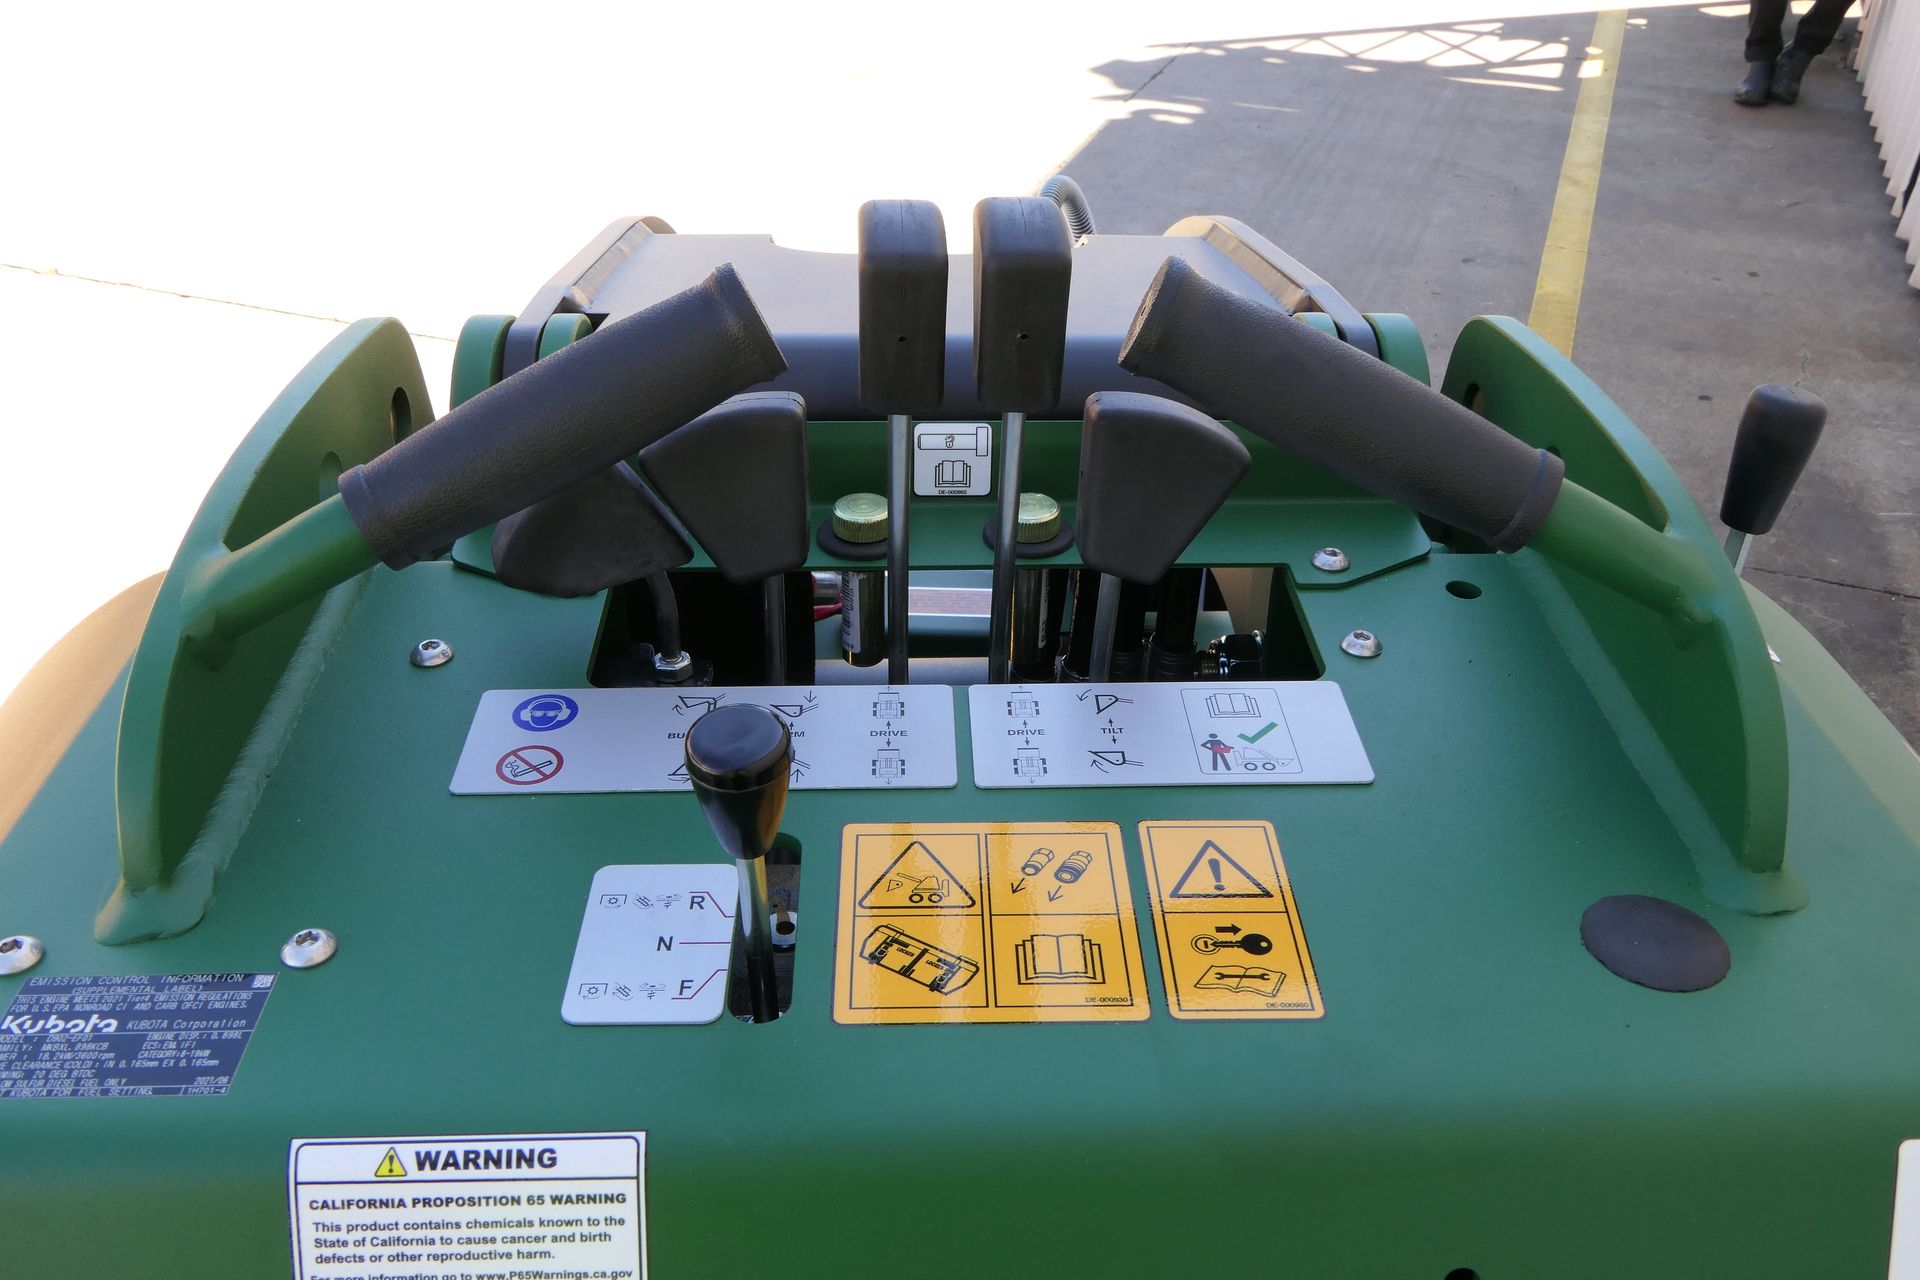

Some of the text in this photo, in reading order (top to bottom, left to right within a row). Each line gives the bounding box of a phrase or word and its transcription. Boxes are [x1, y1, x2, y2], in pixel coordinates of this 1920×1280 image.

[869, 729, 908, 737] DRIVE
[689, 895, 705, 910] R
[656, 936, 673, 951] N
[30, 973, 244, 986] EMISSION CONTROL INFORMATION
[679, 980, 694, 996] F
[1, 1014, 118, 1033] Kubota
[126, 1018, 247, 1030] KUBOTA Corporation
[415, 1148, 558, 1171] WARNING
[309, 1193, 627, 1211] CALIFORNIA PROPOSITION 65 WARNING
[313, 1216, 625, 1234] This product contains chemicals known to the
[314, 1231, 612, 1248] State of California to cause cancer and birth
[315, 1249, 556, 1265] defects or other reproductive harm.
[476, 1270, 633, 1280] www.P65Warnings.ca.gov
